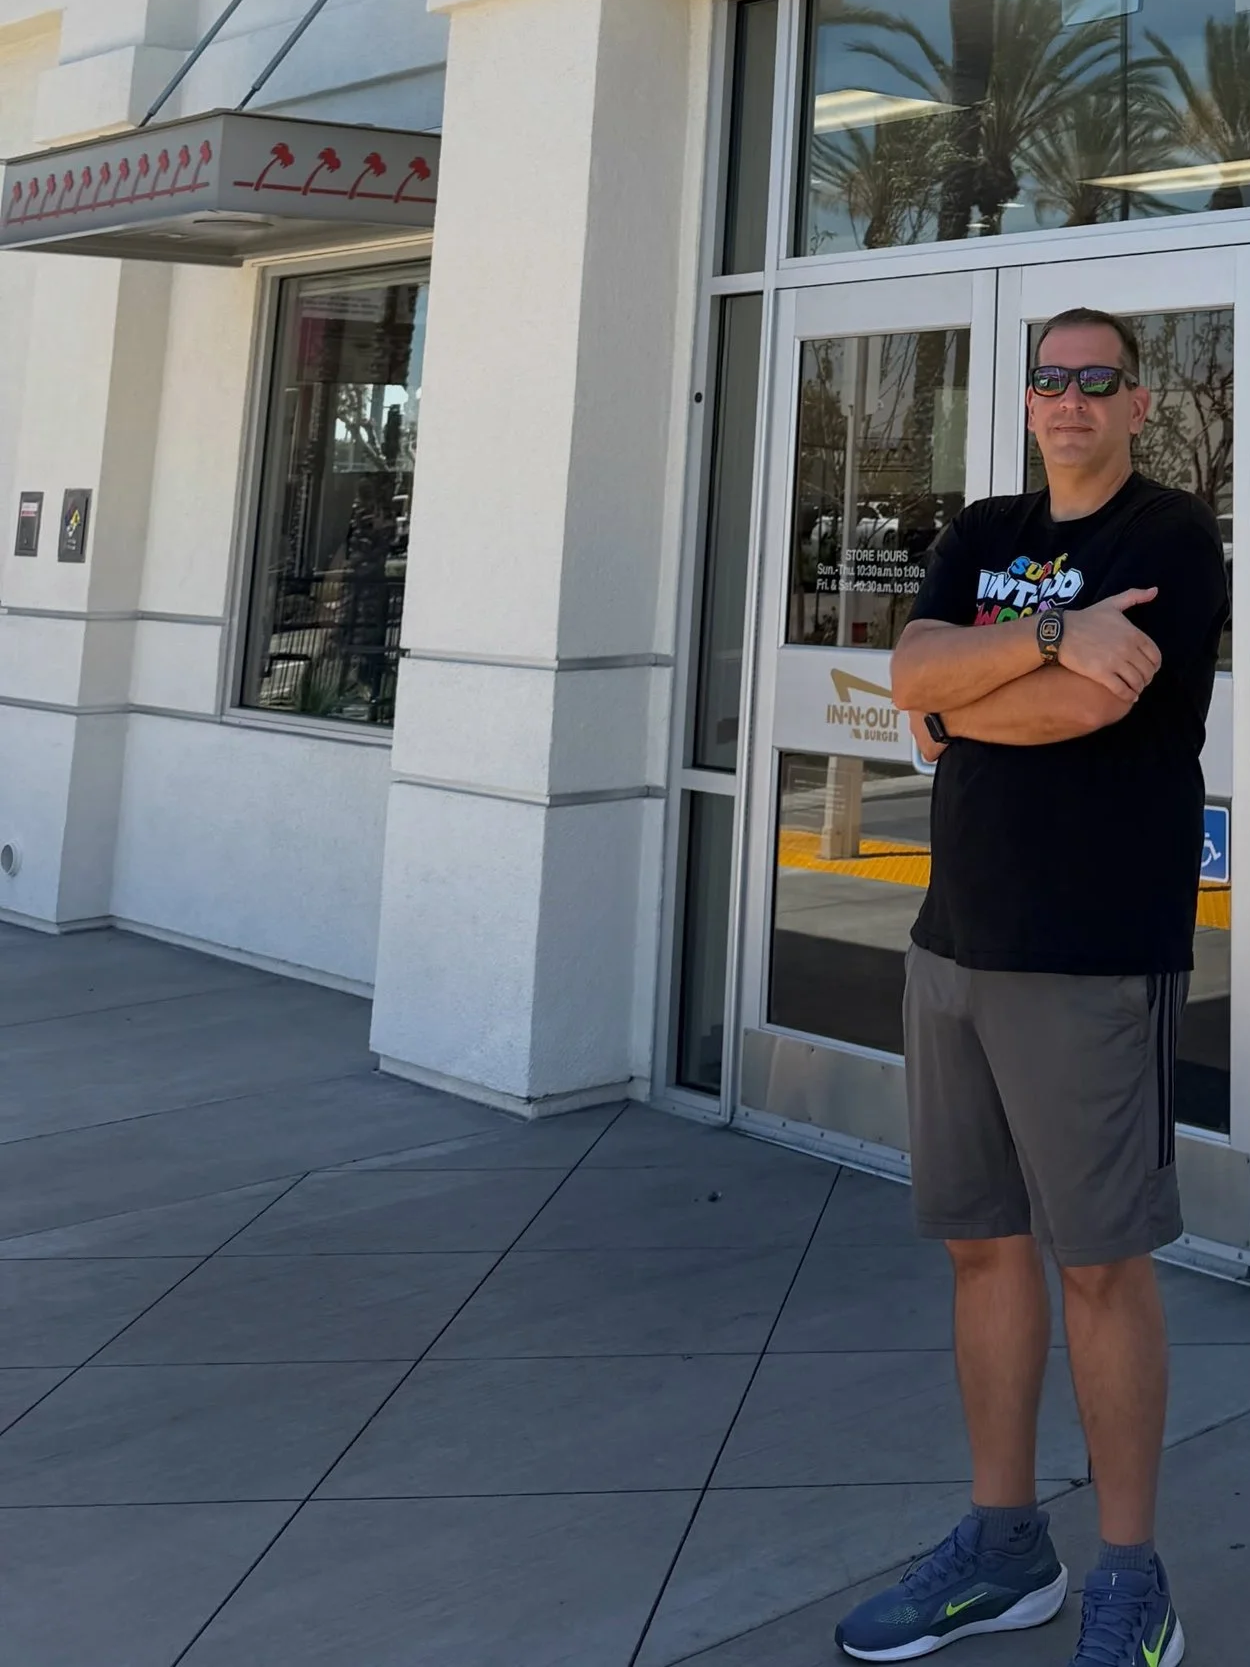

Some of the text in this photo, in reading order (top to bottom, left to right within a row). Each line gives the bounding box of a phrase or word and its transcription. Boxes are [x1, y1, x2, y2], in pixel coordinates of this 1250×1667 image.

[845, 549, 909, 562] STORE HOURS
[830, 579, 837, 591] &
[864, 729, 899, 743] BURGER
